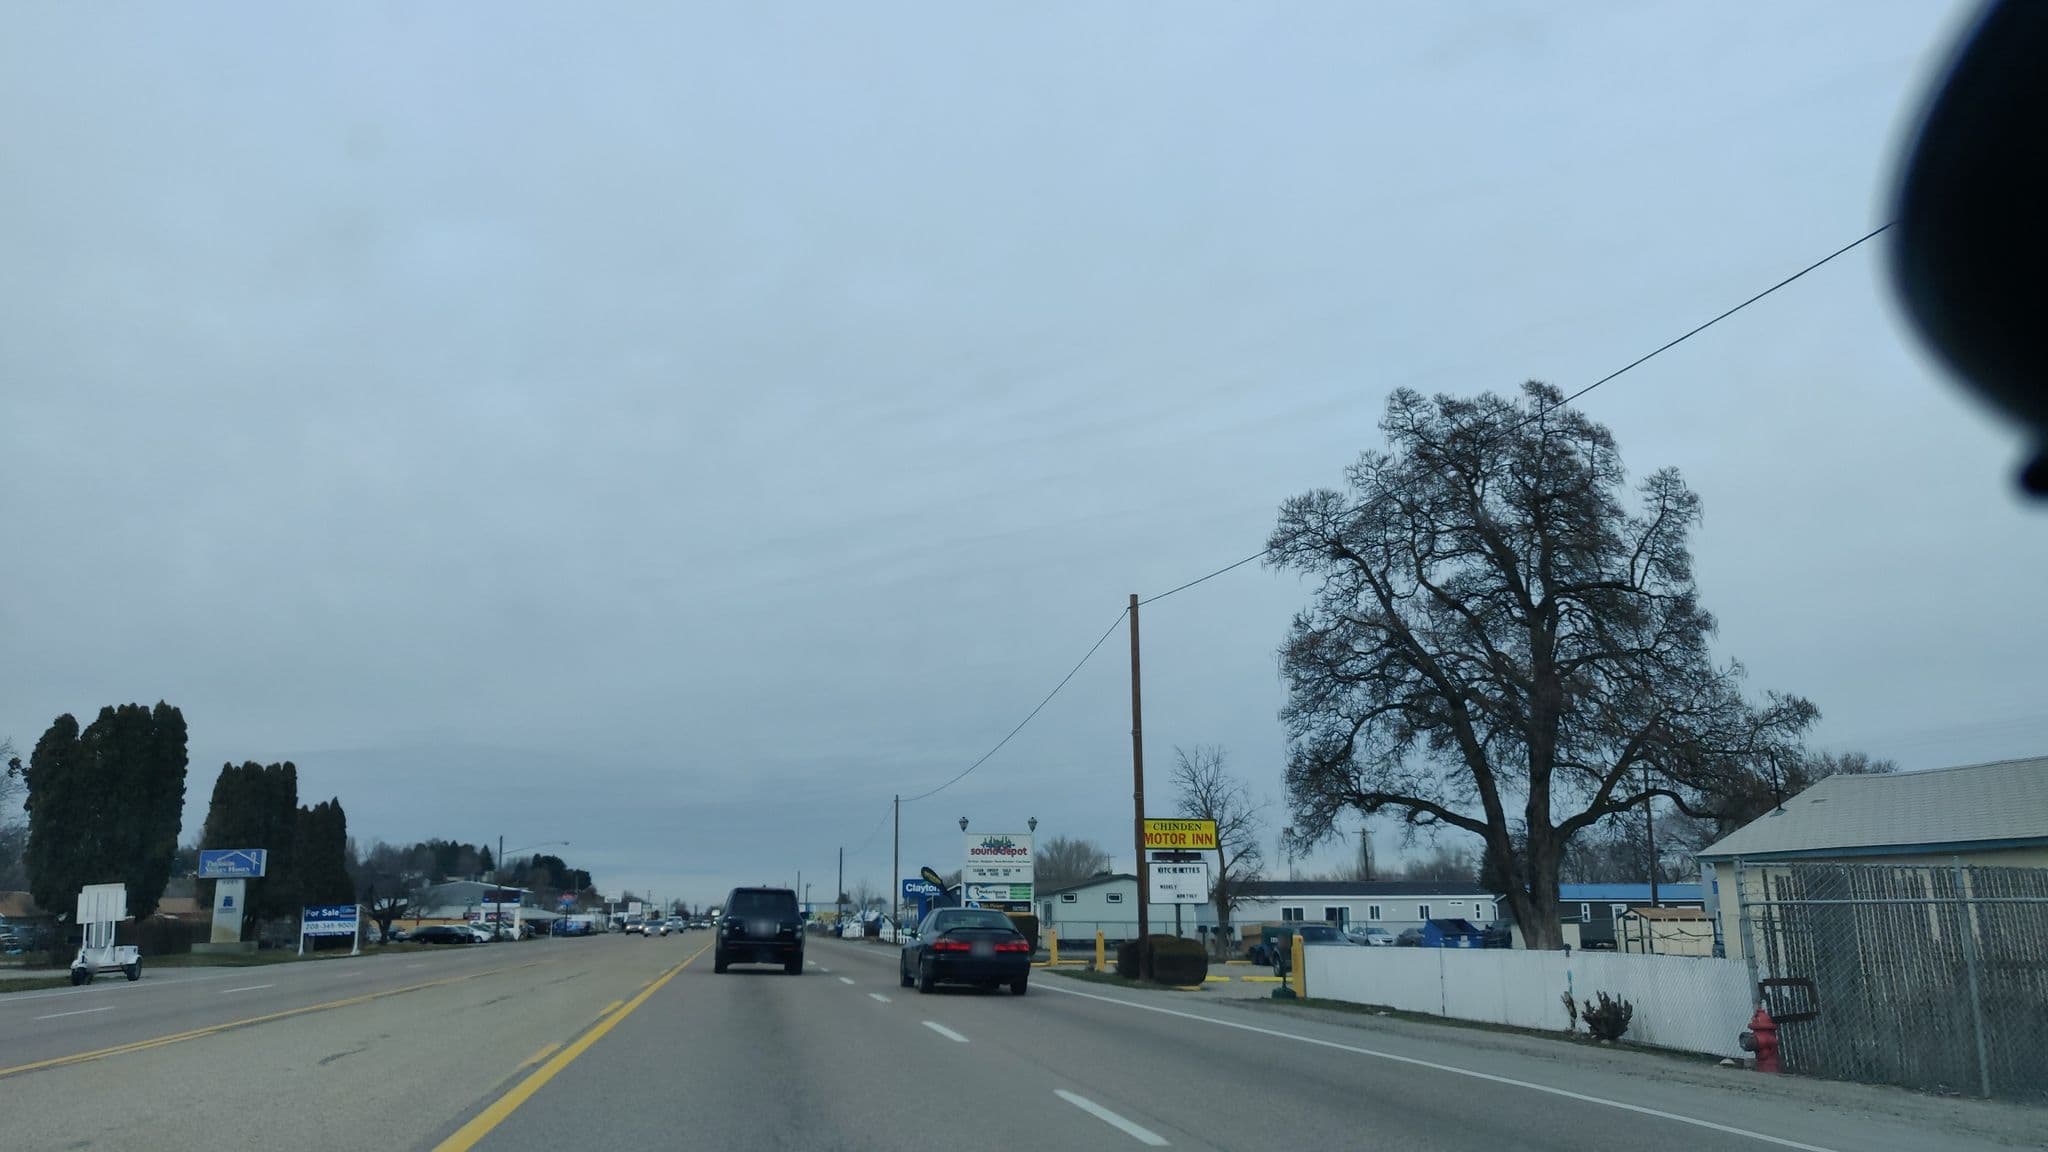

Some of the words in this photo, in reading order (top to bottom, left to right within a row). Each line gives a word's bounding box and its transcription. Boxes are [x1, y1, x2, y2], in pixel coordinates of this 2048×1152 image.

[1153, 823, 1202, 831] CHINDEN
[1144, 833, 1186, 844] MOTOR
[1192, 833, 1213, 845] INN
[305, 909, 319, 917] For
[322, 908, 339, 917] Sale
